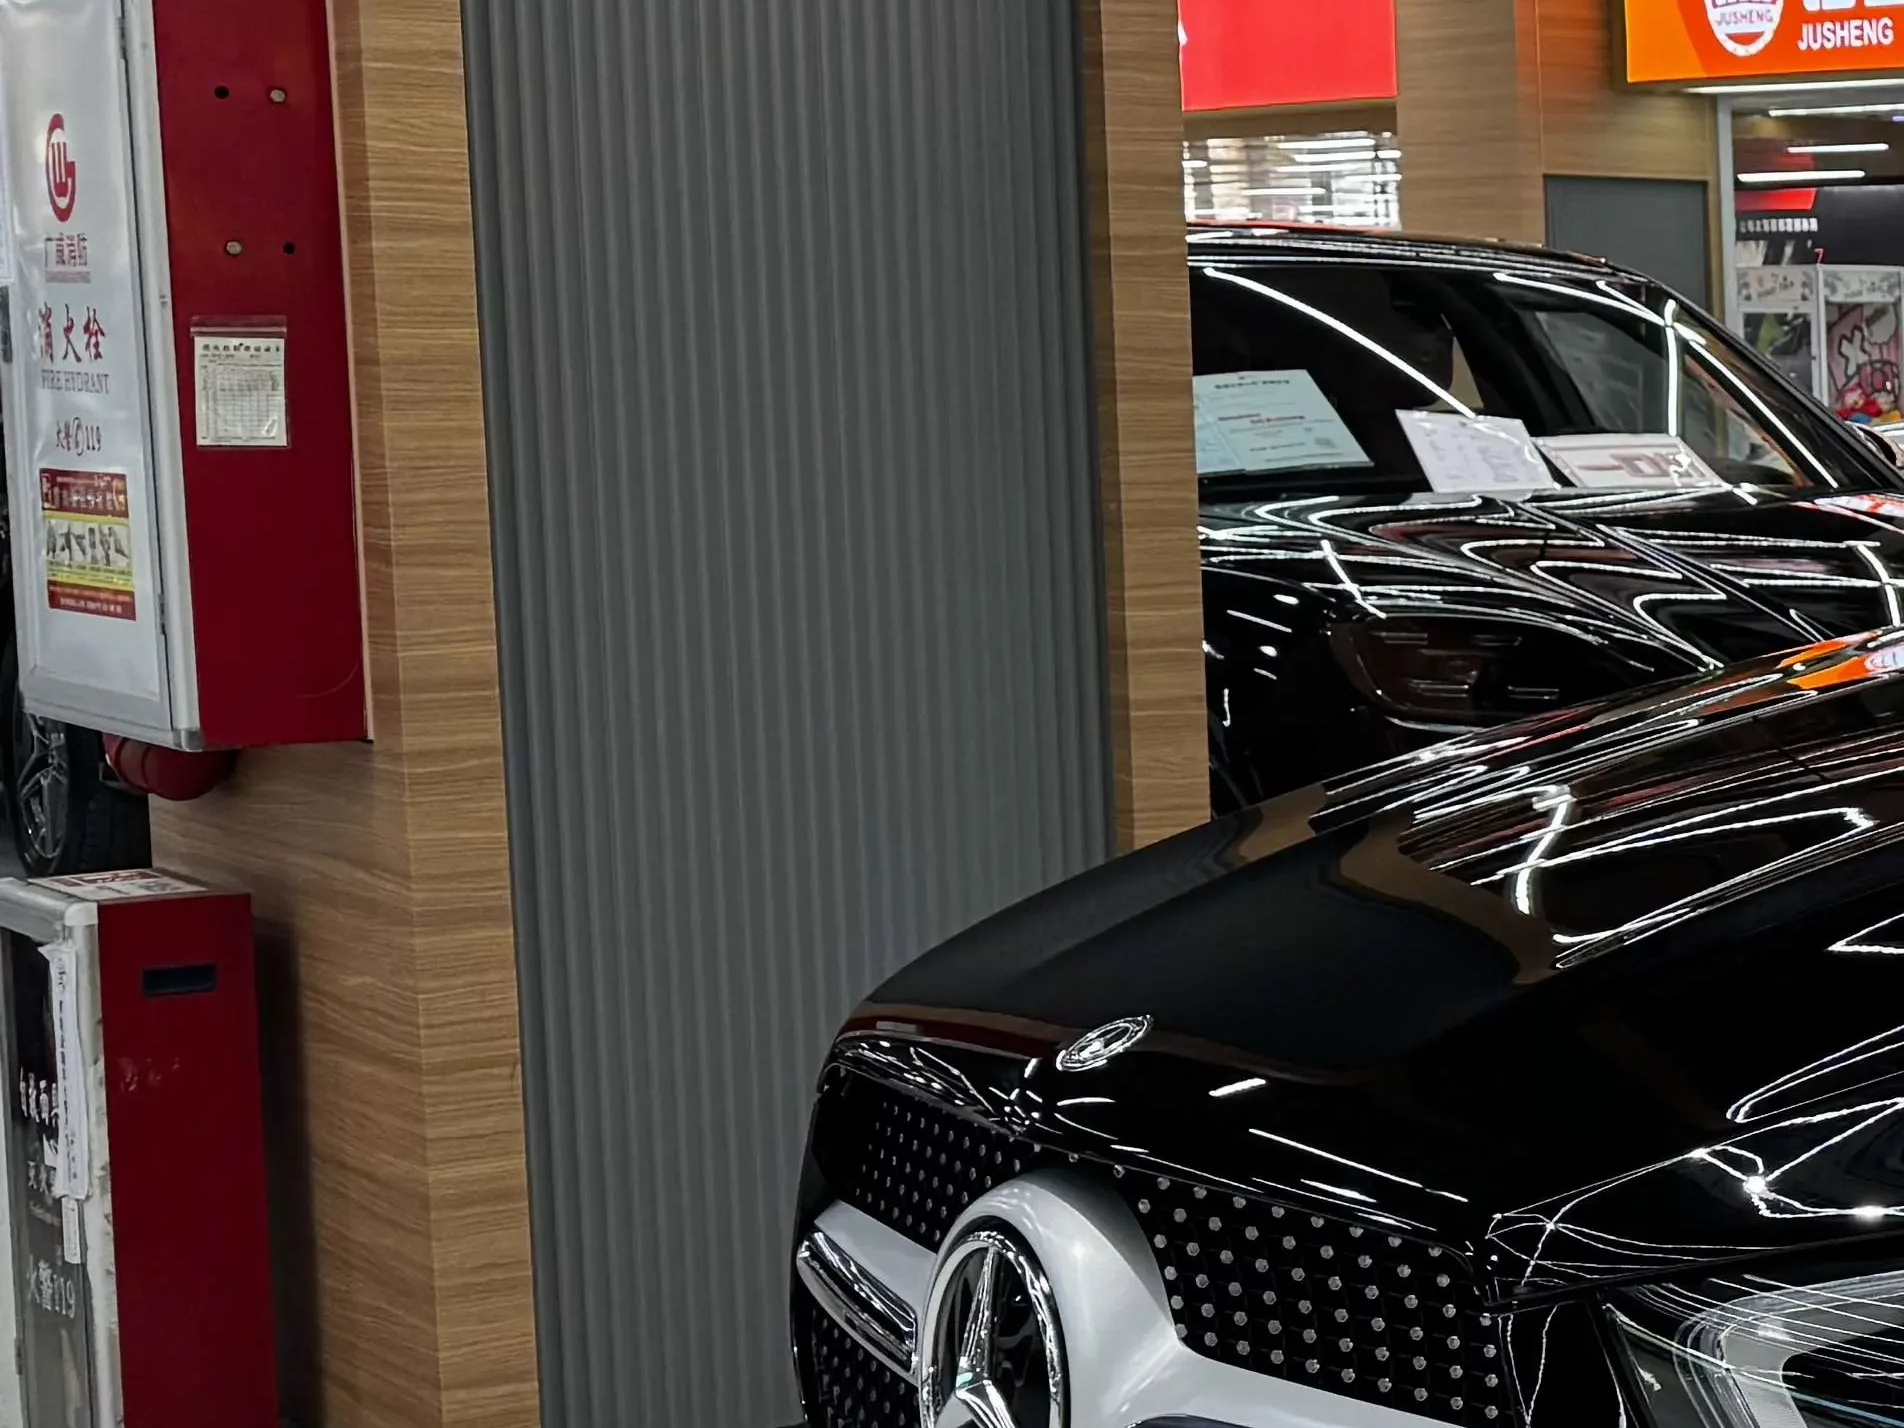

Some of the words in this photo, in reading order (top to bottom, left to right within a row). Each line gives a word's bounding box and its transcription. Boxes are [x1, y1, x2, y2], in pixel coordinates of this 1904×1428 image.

[1715, 9, 1774, 27] JUSHENG
[1797, 16, 1894, 51] JUSHENG
[38, 302, 105, 363] 消火栓
[41, 369, 63, 390] FIRE
[85, 425, 102, 451] 119
